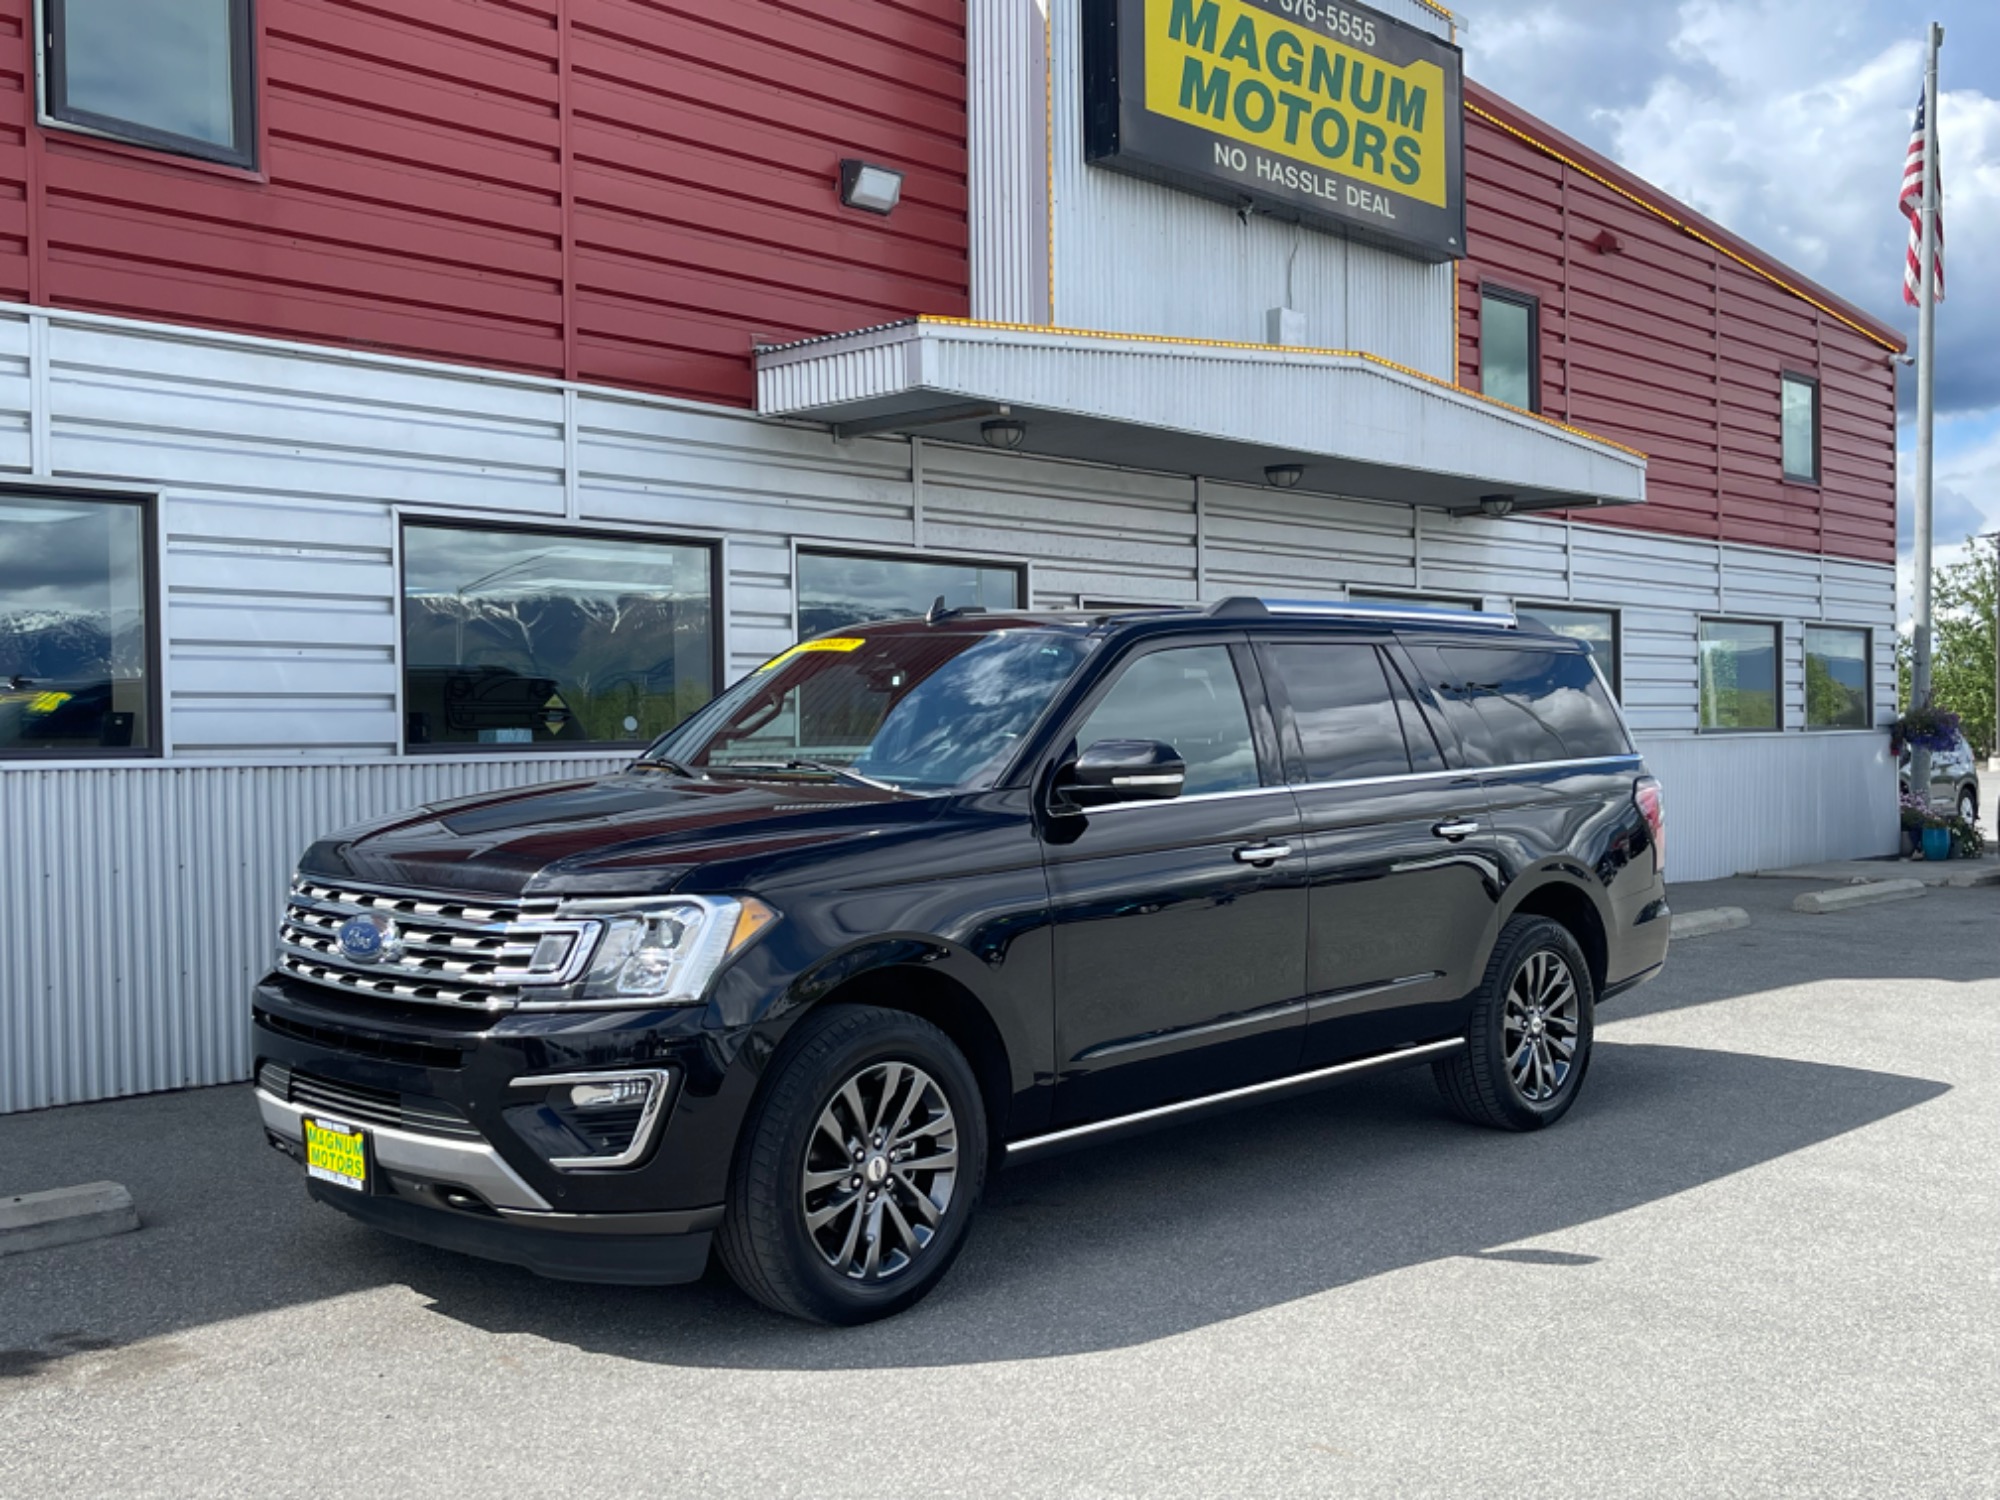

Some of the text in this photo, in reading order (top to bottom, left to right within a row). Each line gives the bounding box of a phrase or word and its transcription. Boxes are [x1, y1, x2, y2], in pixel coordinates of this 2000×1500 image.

[1168, 0, 1427, 133] MAGNUM
[1178, 55, 1422, 185] MOTORS
[1213, 142, 1396, 219] NO HASSLE DEAL
[308, 1127, 364, 1157] MAGNUM
[311, 1147, 362, 1177] MOTORS
